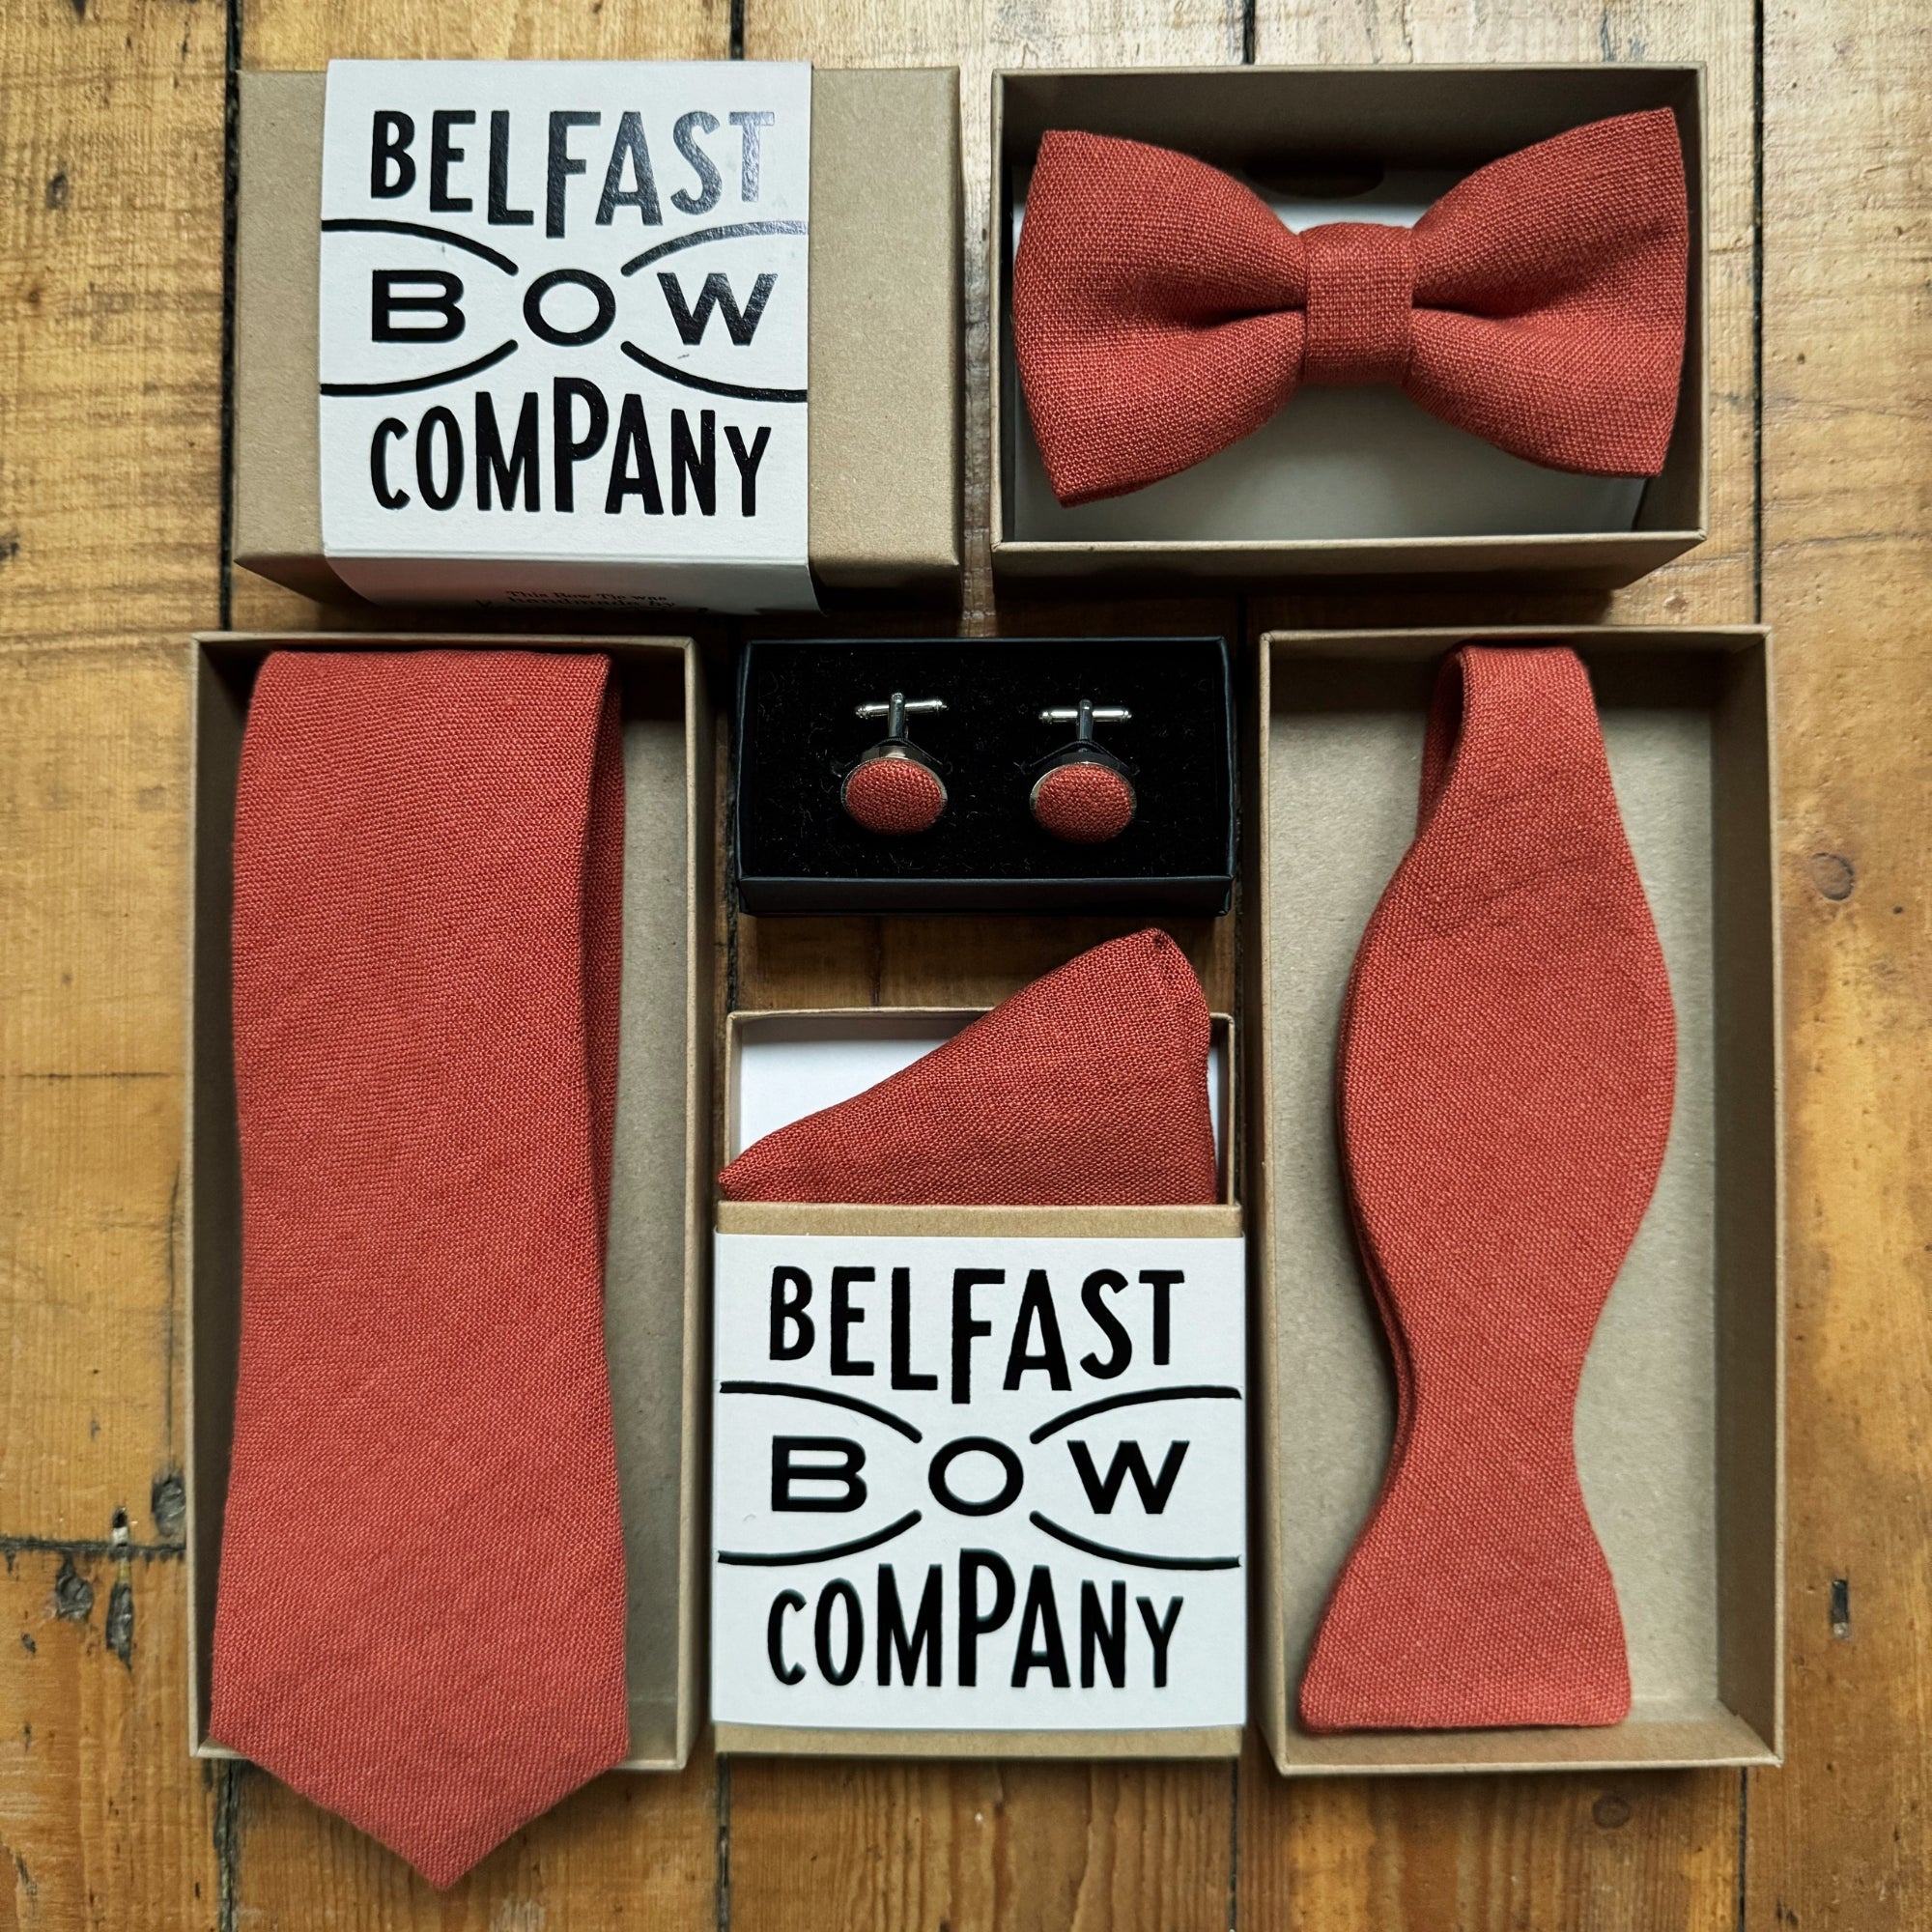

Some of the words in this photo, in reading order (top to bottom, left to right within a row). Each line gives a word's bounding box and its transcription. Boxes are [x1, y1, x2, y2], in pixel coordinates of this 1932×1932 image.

[370, 109, 775, 239] BELFAST
[371, 268, 779, 348] BOW
[370, 376, 772, 517] COMPANY
[769, 1265, 1186, 1405] BELFAST
[771, 1435, 1191, 1518] BOW
[767, 1548, 1184, 1689] COMPANY
